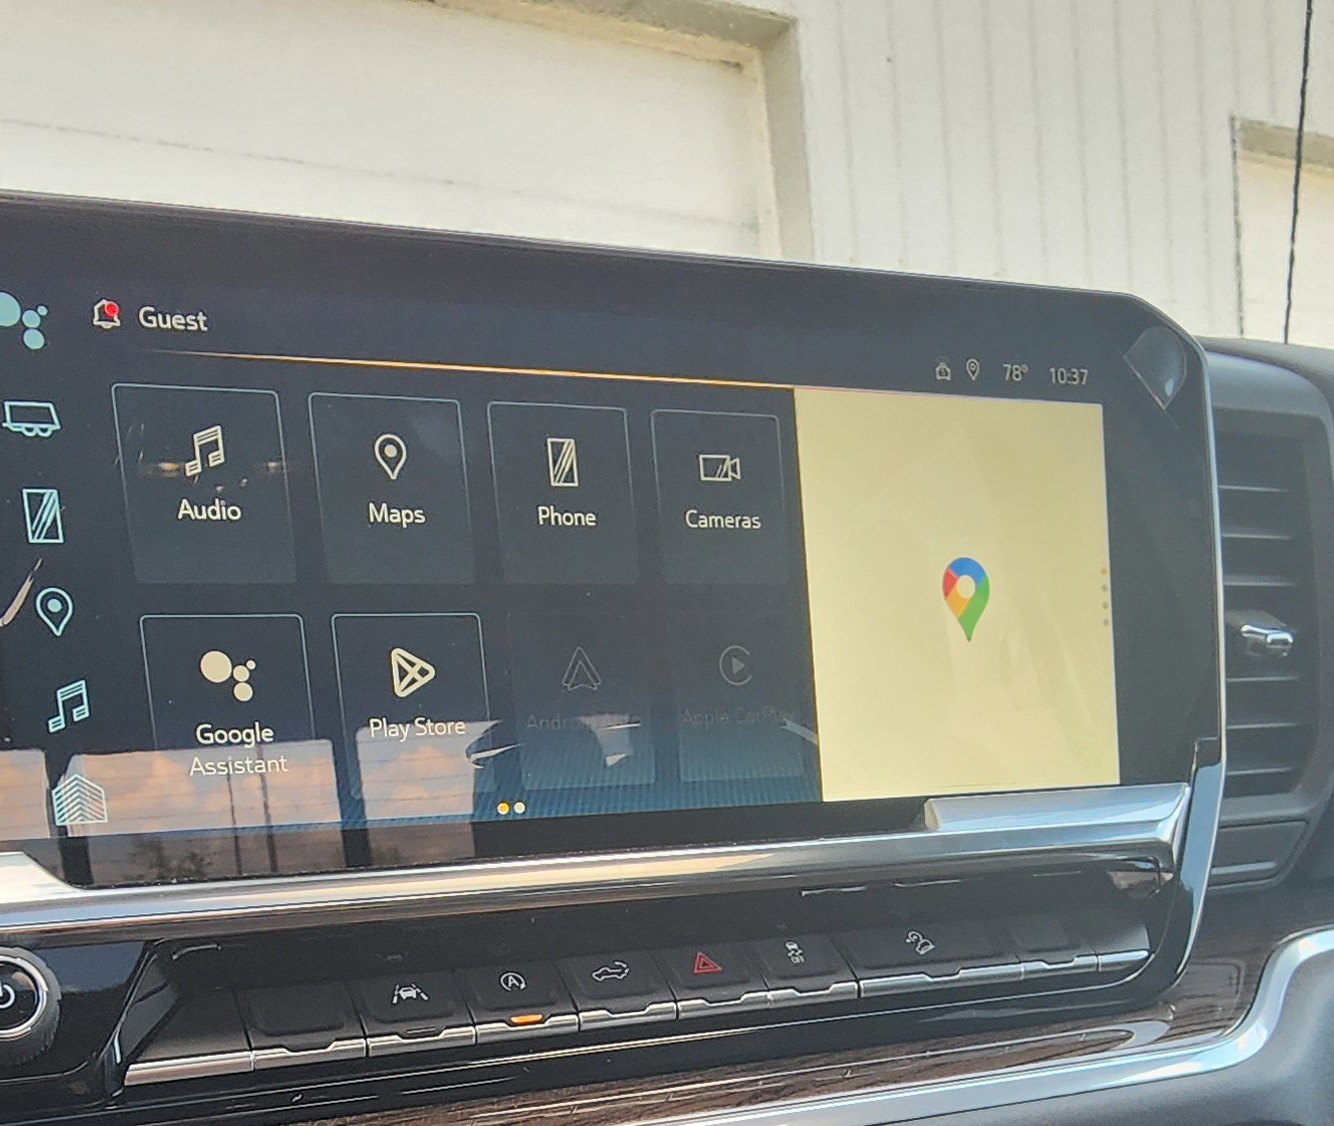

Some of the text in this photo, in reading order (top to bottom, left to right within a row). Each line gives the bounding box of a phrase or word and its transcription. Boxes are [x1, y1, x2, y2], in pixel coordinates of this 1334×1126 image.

[138, 306, 208, 332] Guest
[1049, 367, 1089, 385] 10:37
[177, 498, 242, 522] Audio
[369, 502, 425, 526] Maps
[537, 506, 597, 527] Phone
[685, 510, 761, 529] Cameras
[196, 722, 274, 748] Google
[369, 716, 466, 741] Play Store
[189, 755, 288, 777] Assistant
